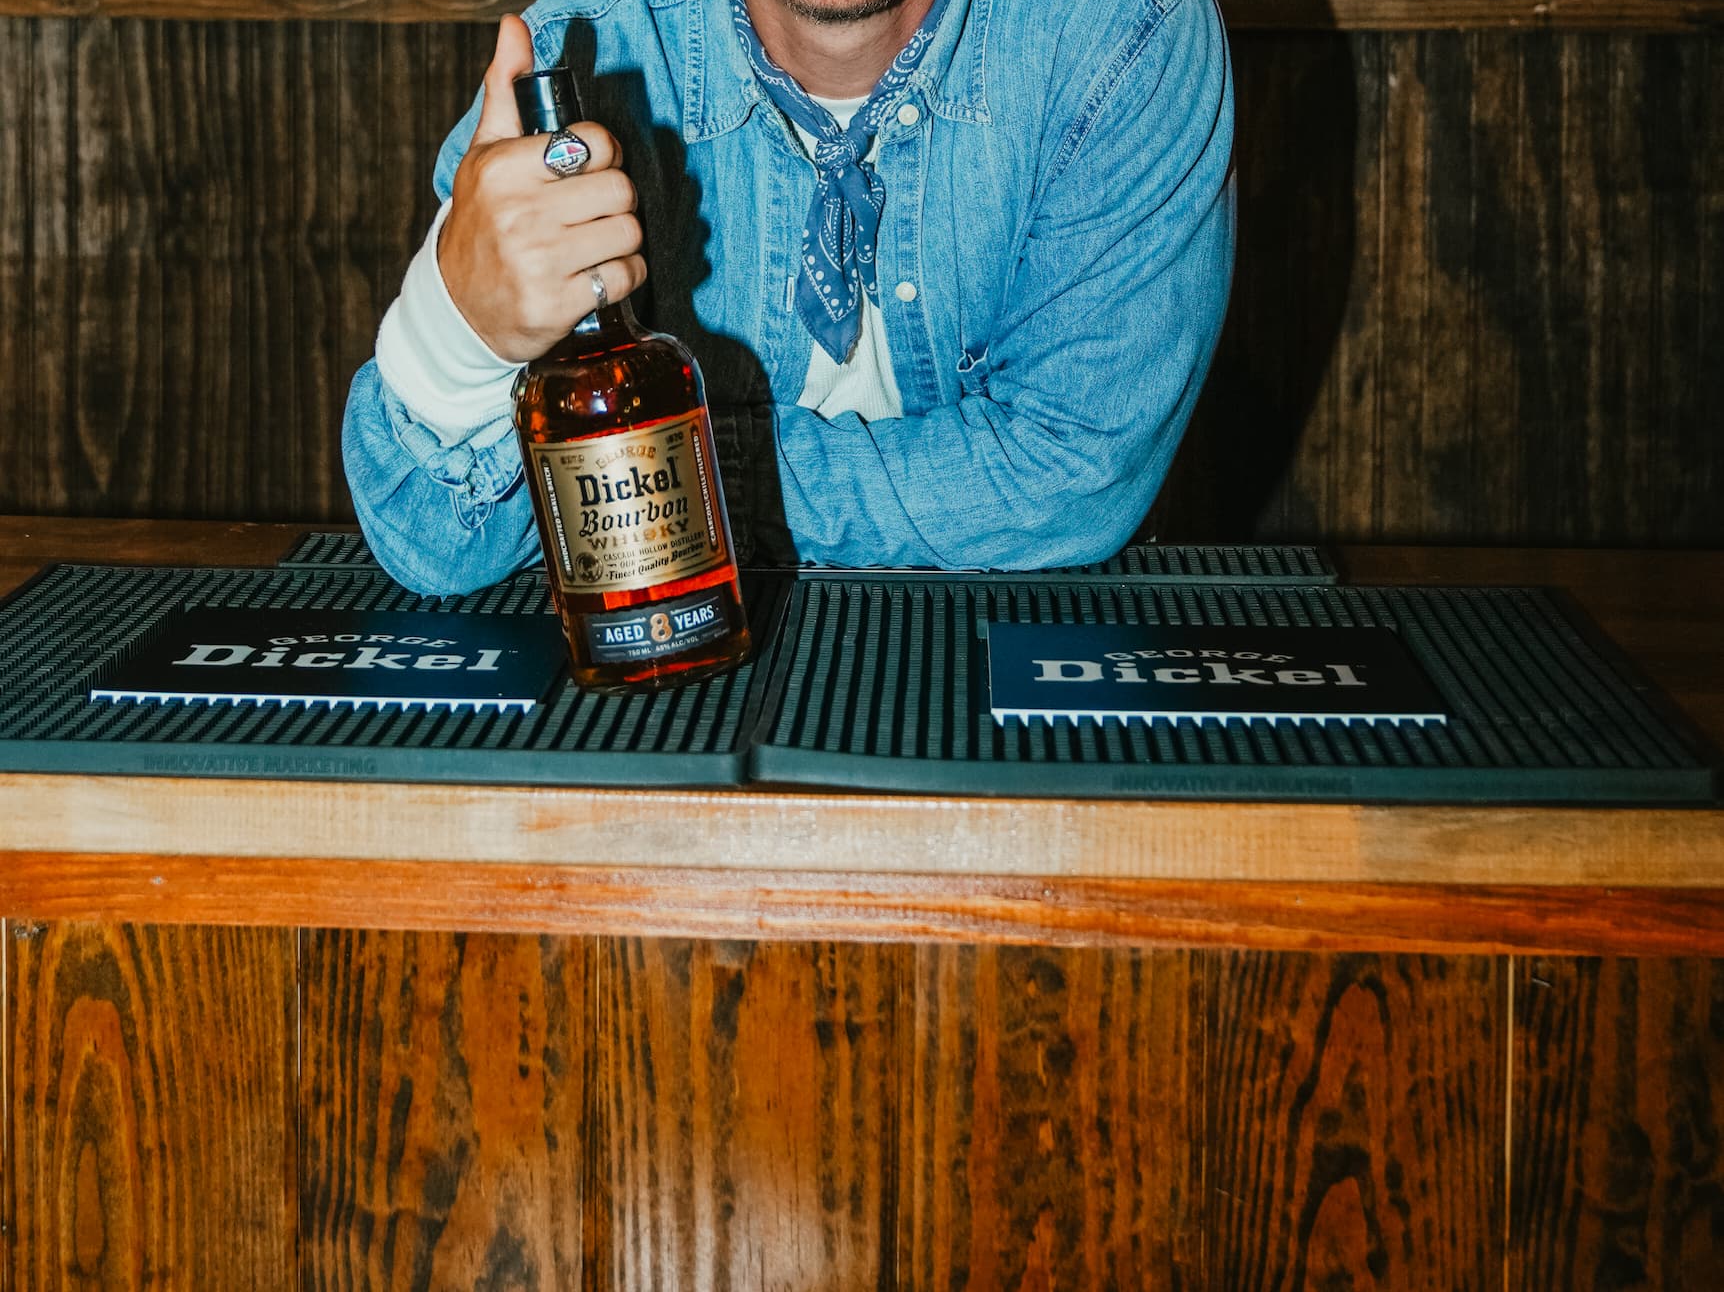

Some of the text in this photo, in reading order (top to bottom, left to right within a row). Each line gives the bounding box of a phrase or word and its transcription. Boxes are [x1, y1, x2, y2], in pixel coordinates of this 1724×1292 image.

[595, 445, 657, 469] GEORGE
[543, 465, 554, 492] BATCH
[576, 456, 681, 507] Dickel
[548, 491, 560, 517] SMALL
[579, 496, 689, 538] Bourbon
[587, 517, 689, 551] WHISKY
[639, 544, 668, 556] HOLLOW
[638, 557, 669, 575] Quality
[605, 604, 715, 643] AGED 8 YEARS
[268, 634, 460, 648] GEORGE
[172, 644, 503, 671] Dickel
[1104, 649, 1296, 663] GEORGE
[1032, 659, 1367, 686] Dickel
[143, 755, 377, 774] INNOVATIVE MARKETING
